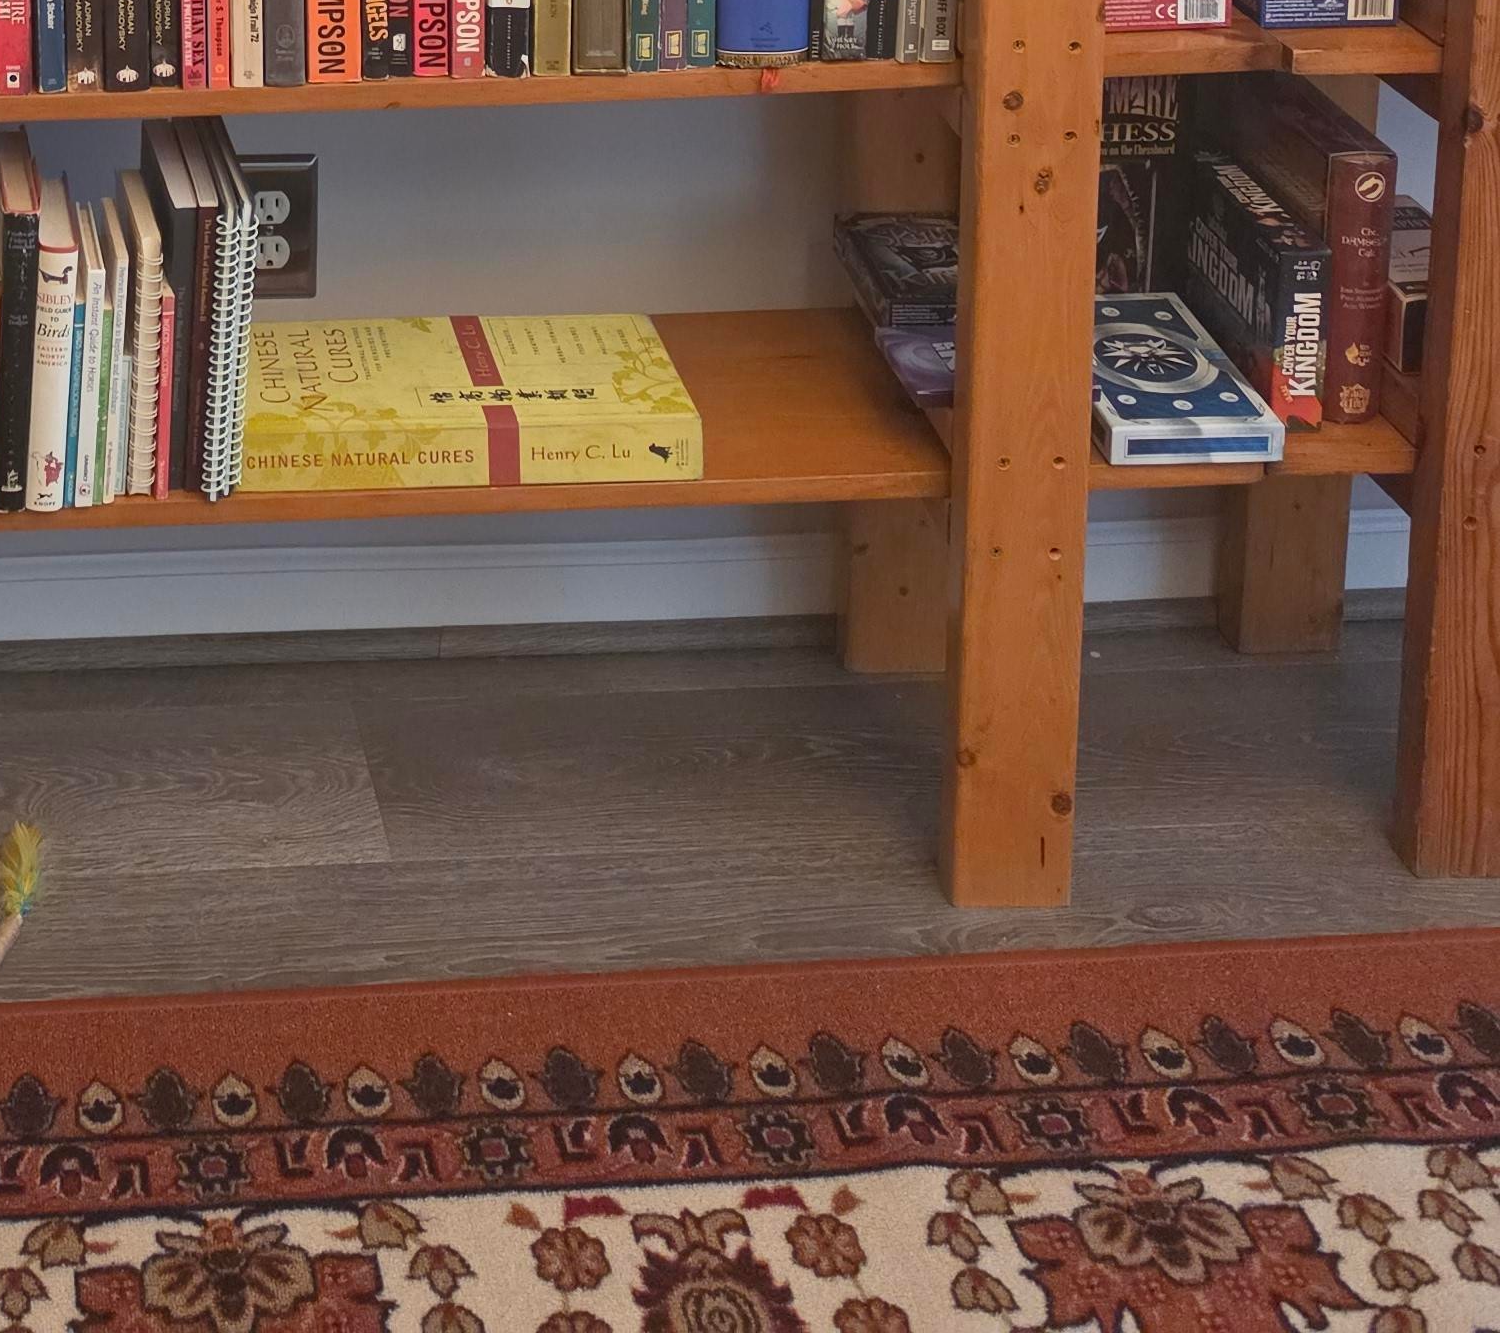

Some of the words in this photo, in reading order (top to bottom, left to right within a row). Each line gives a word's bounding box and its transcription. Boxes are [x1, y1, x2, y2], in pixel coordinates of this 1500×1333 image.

[1285, 317, 1297, 345] YOUR
[1289, 293, 1321, 397] KINGDOM
[254, 330, 291, 404] CHINESE
[289, 330, 327, 411] NATURAL
[323, 329, 359, 383] CURES
[1282, 349, 1296, 376] COVER
[246, 454, 324, 469] CHINESE
[331, 453, 411, 466] NATURAL
[417, 450, 475, 463] CURES
[531, 446, 581, 462] Henry
[585, 446, 605, 460] C.
[612, 445, 630, 459] Lu
